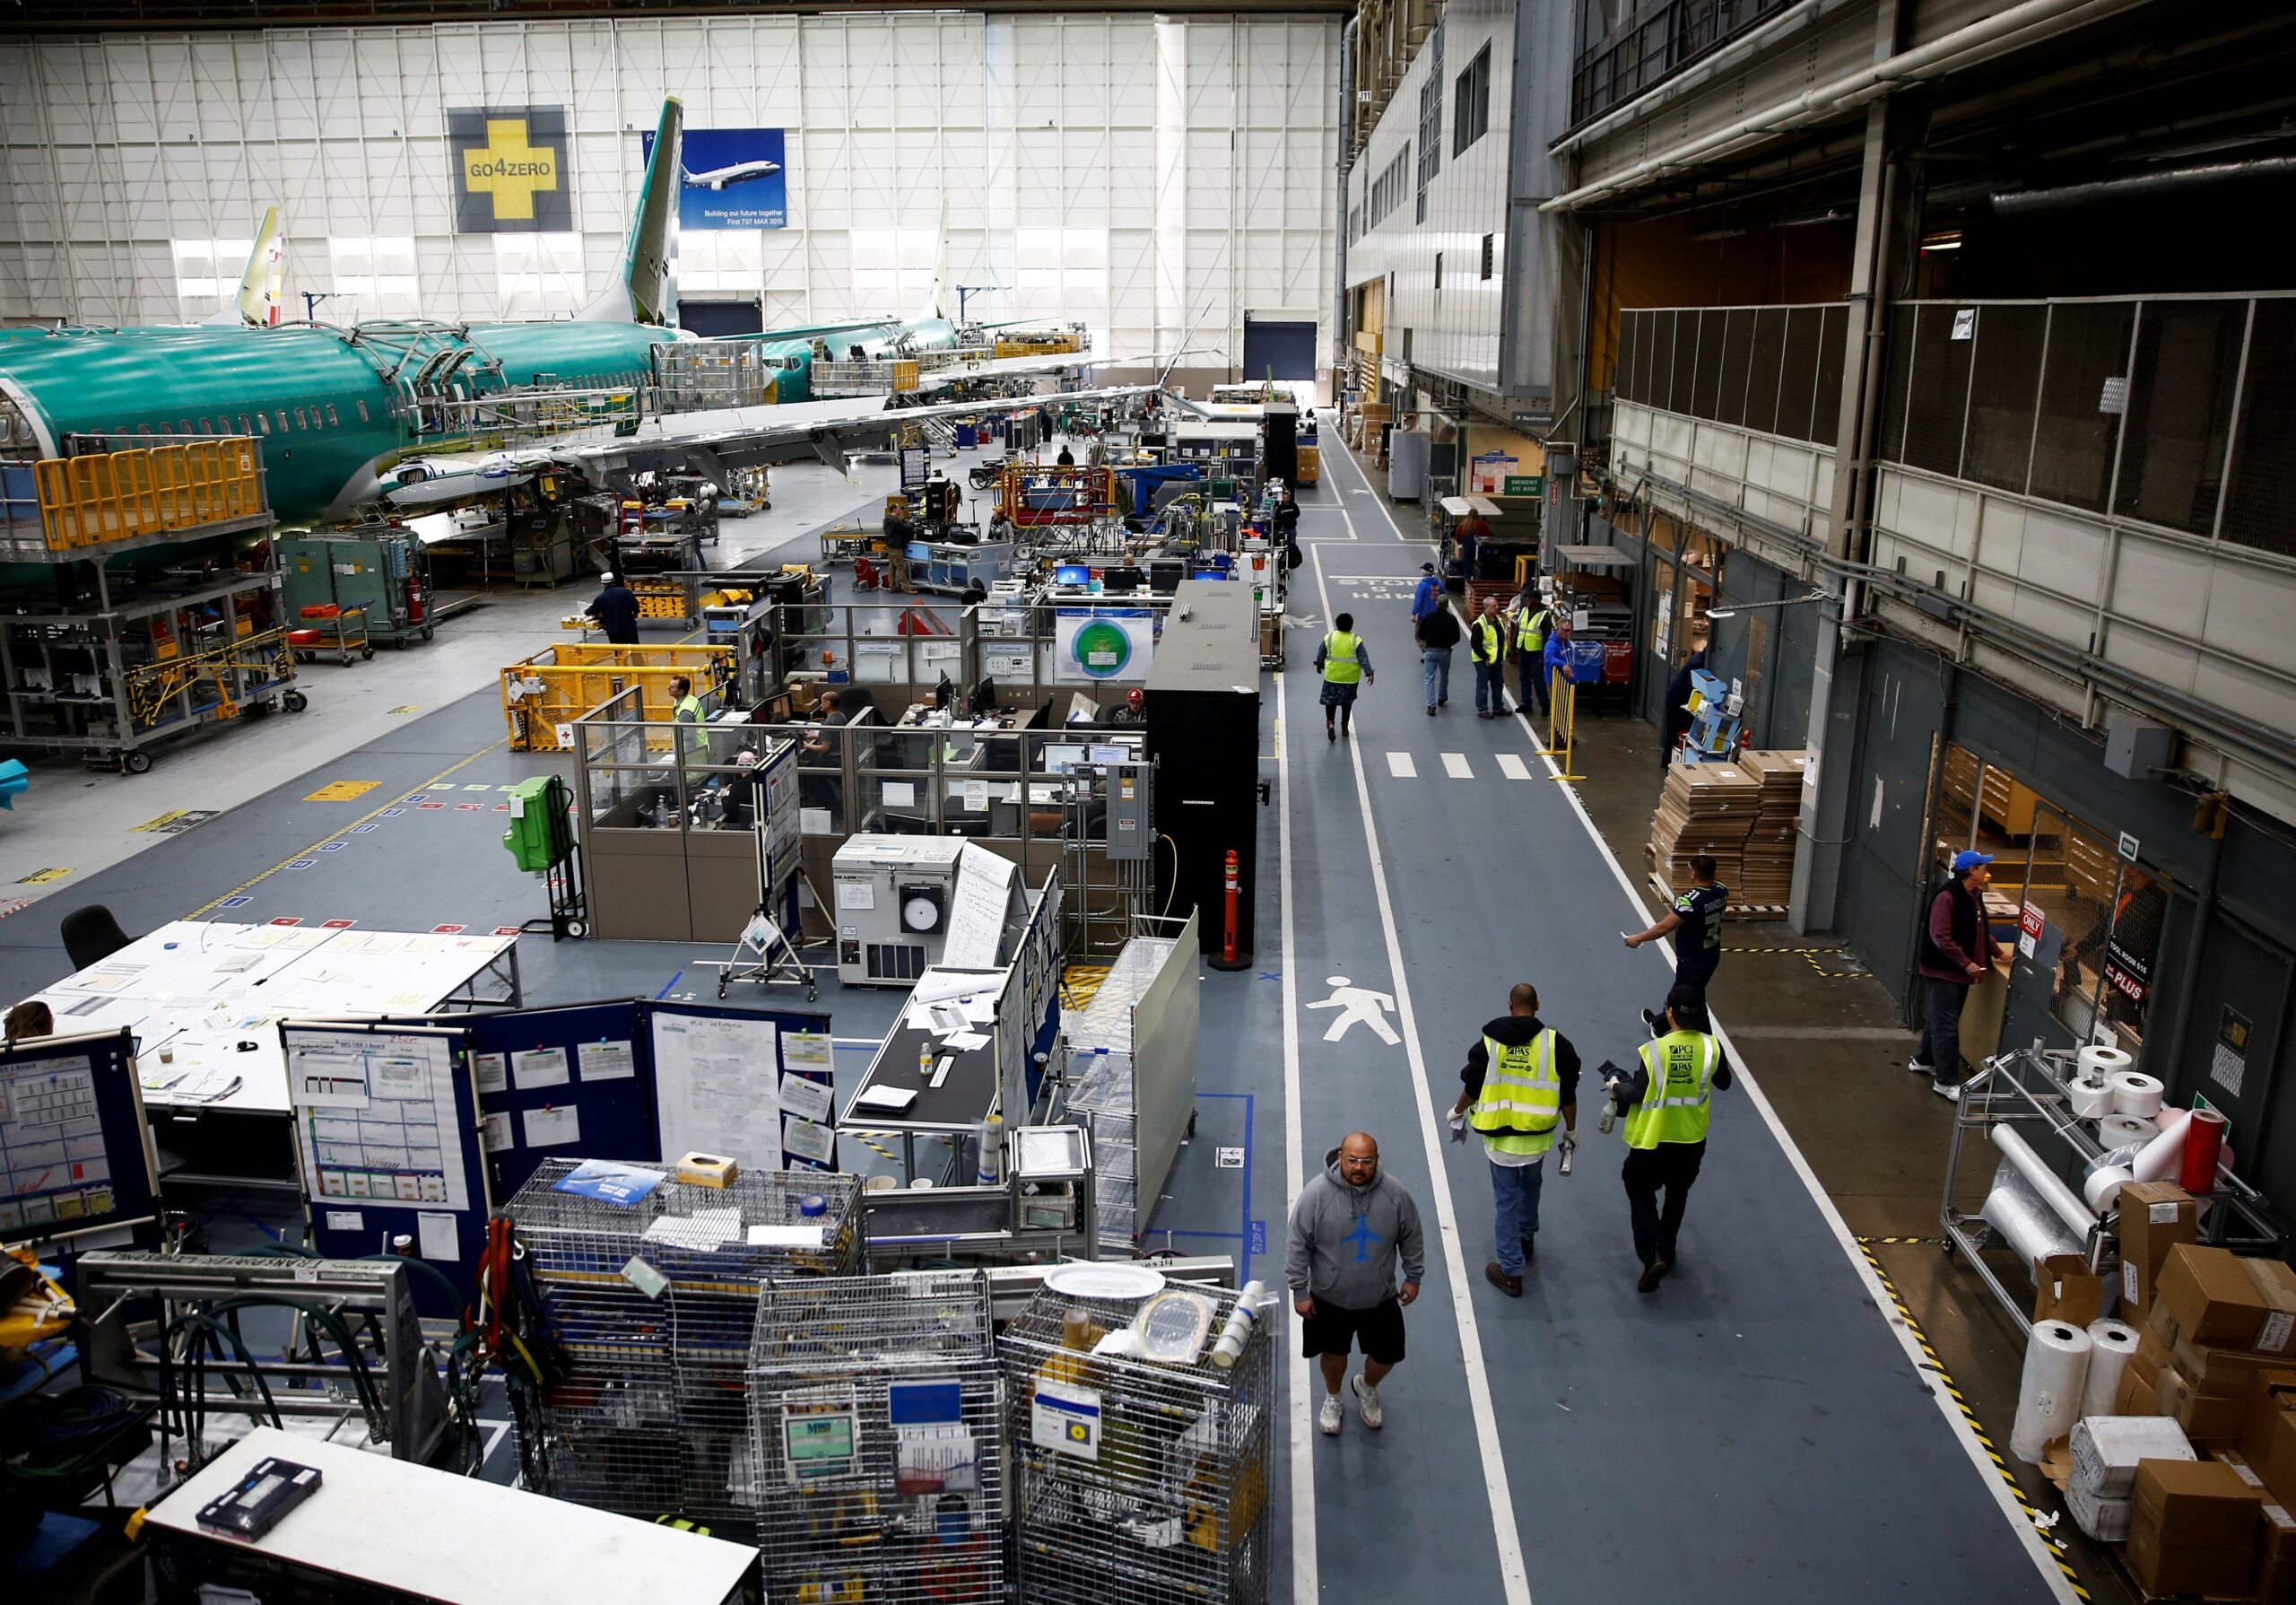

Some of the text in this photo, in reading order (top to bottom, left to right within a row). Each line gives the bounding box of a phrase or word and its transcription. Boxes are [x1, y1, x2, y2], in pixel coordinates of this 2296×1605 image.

[470, 157, 551, 177] GO4ZERO
[704, 209, 728, 218] Building
[758, 209, 783, 217] together
[2023, 914, 2040, 932] ONLY
[2109, 940, 2147, 974] TOOL ROOM 616
[2114, 972, 2142, 999] PLUS
[1514, 1047, 1530, 1056] PAS
[1678, 1044, 1693, 1054] PCI
[1678, 1062, 1692, 1070] PAS
[202, 1257, 323, 1269] TRANSPORTER
